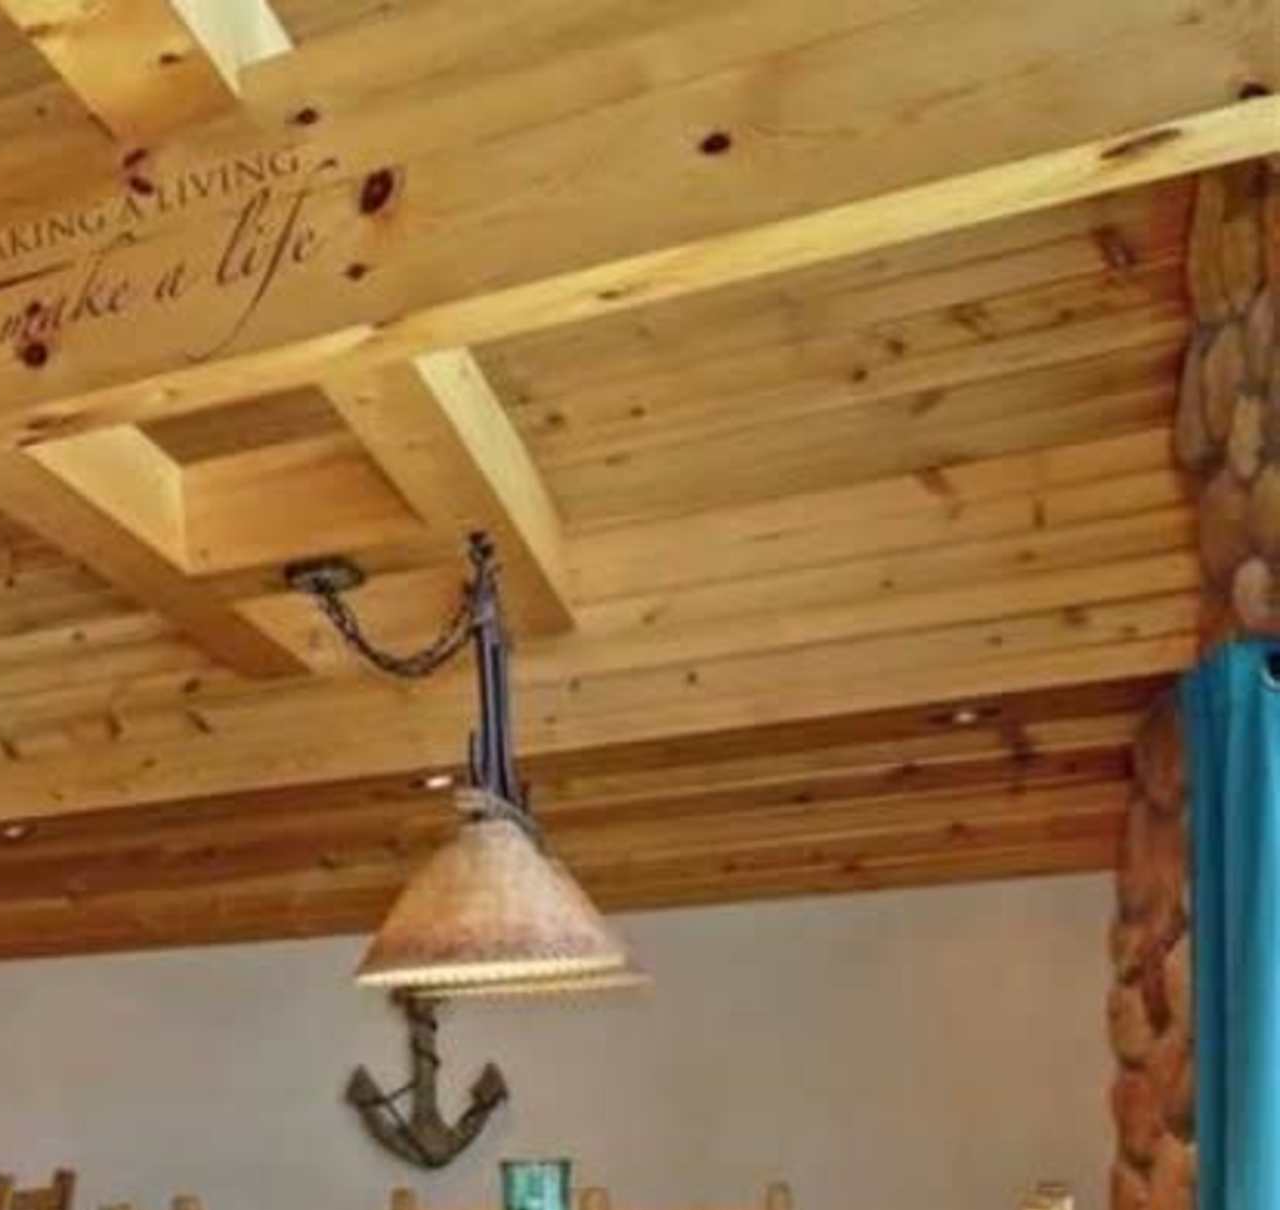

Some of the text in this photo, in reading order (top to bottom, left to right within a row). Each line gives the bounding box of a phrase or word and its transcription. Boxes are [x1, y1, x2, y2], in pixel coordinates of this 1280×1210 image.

[114, 195, 149, 223] A
[153, 152, 300, 214] LIVING
[153, 261, 186, 303] a
[186, 160, 340, 365] life
